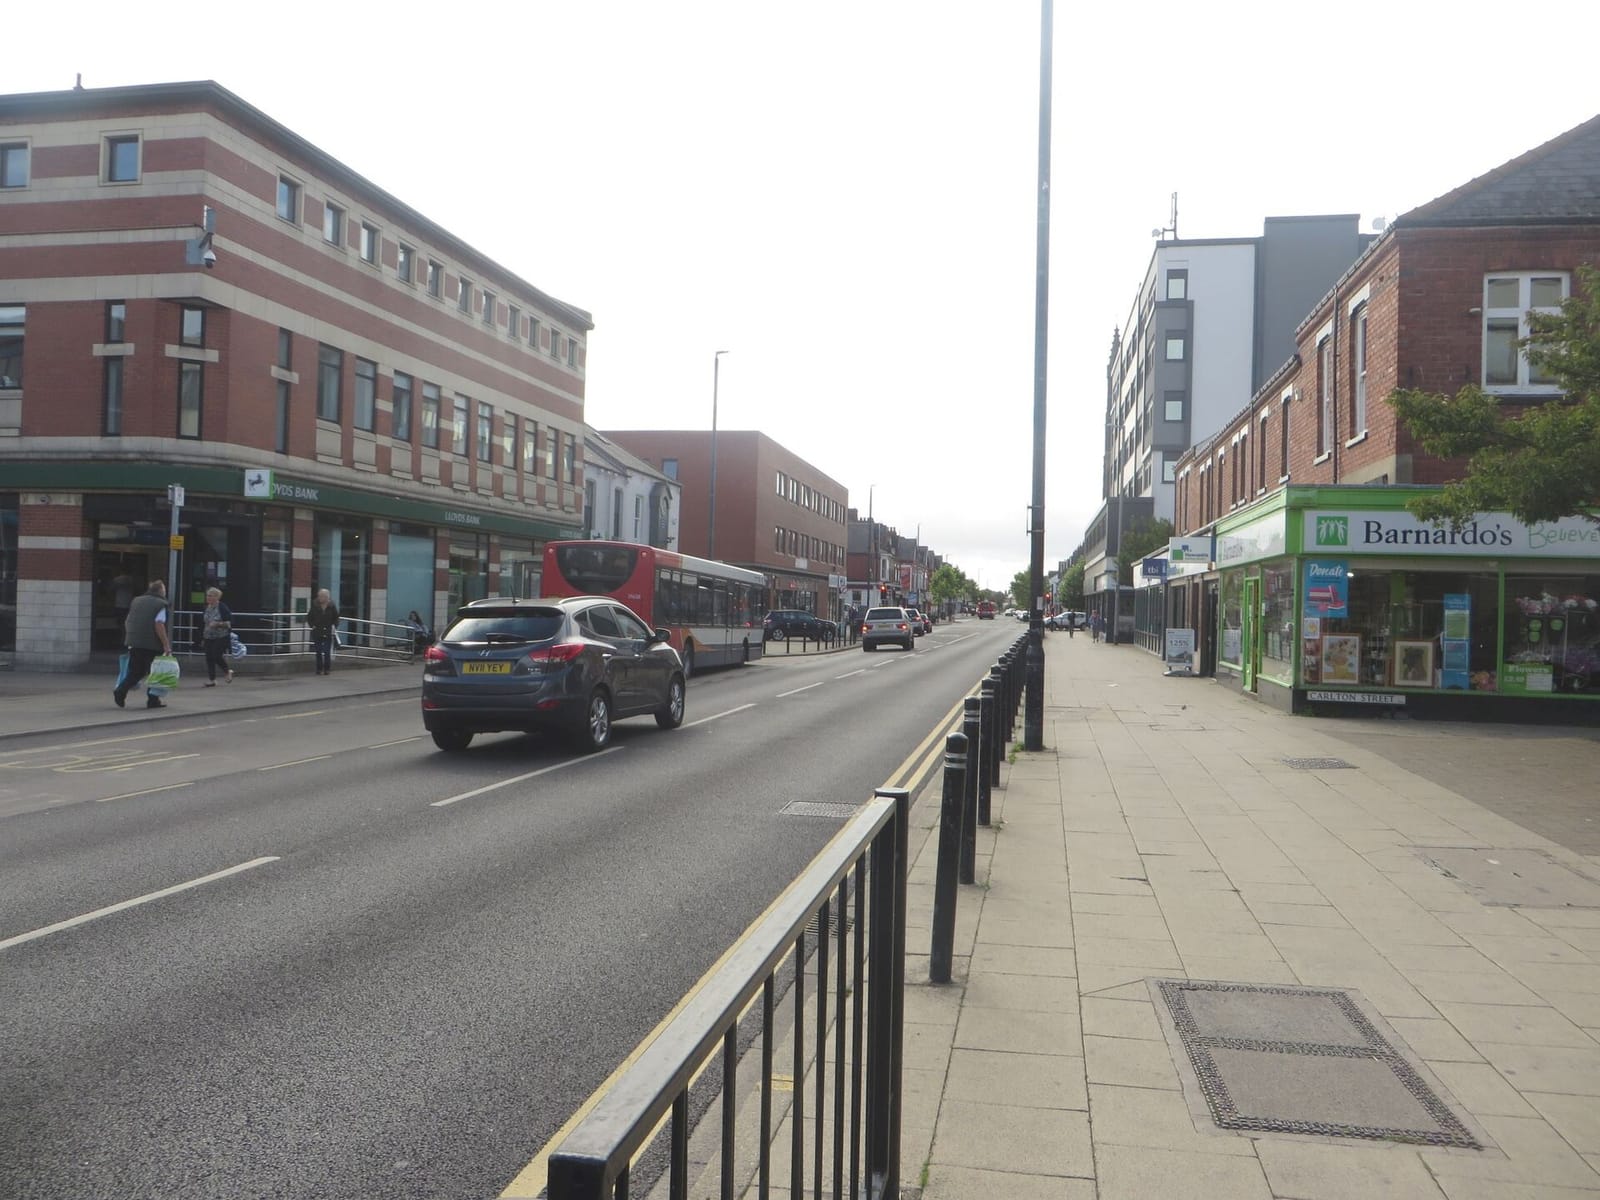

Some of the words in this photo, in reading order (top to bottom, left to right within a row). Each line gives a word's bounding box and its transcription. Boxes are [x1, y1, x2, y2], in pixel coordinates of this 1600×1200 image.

[295, 486, 319, 501] BANK
[1363, 520, 1513, 546] Barnardo's
[1310, 563, 1343, 577] Donate
[486, 663, 504, 673] YEY
[1310, 692, 1356, 701] CARLTON
[1361, 694, 1394, 703] STREET
